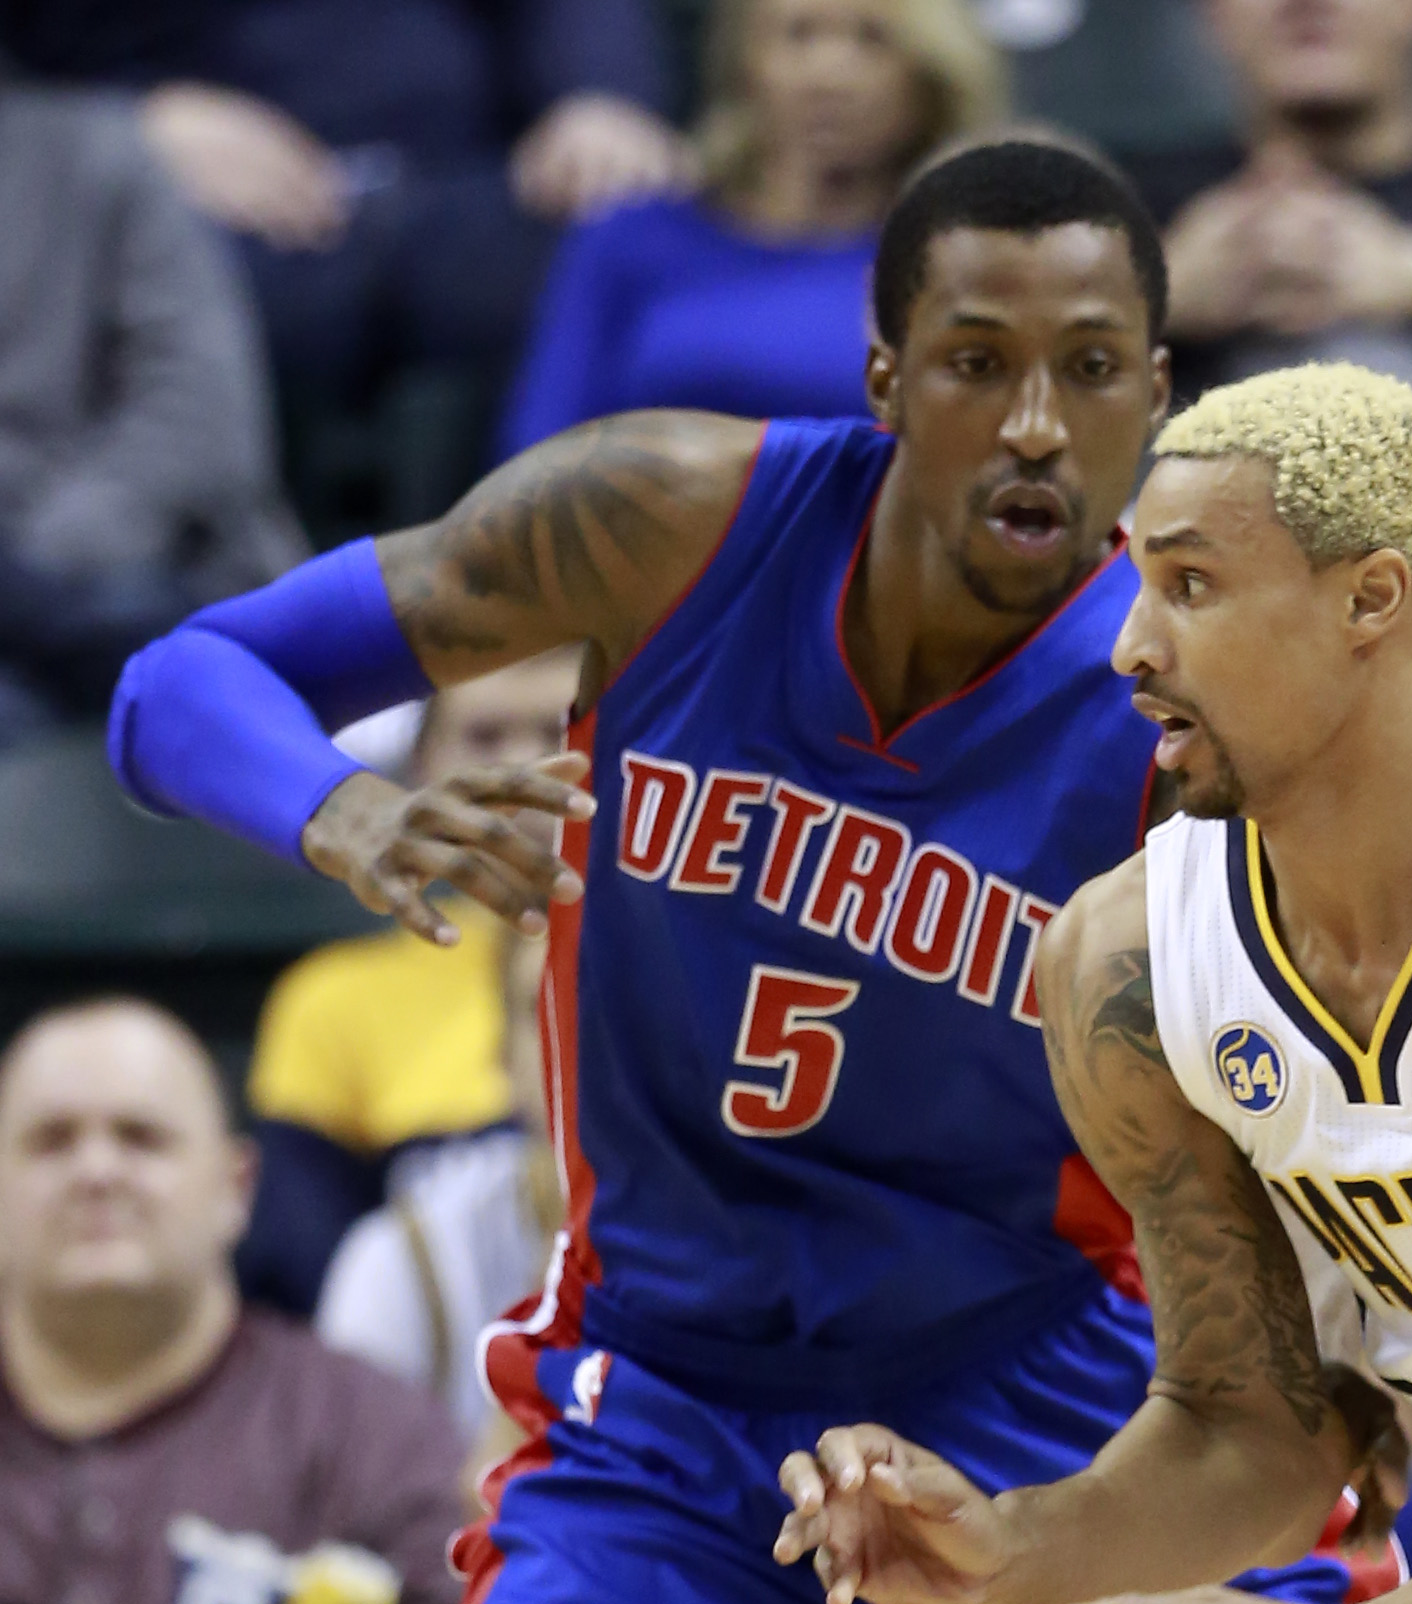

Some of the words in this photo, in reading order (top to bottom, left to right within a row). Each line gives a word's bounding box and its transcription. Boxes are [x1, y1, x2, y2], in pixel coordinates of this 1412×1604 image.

[617, 749, 1062, 1028] DETROIT
[721, 964, 861, 1138] 5
[1226, 1052, 1280, 1101] 34
